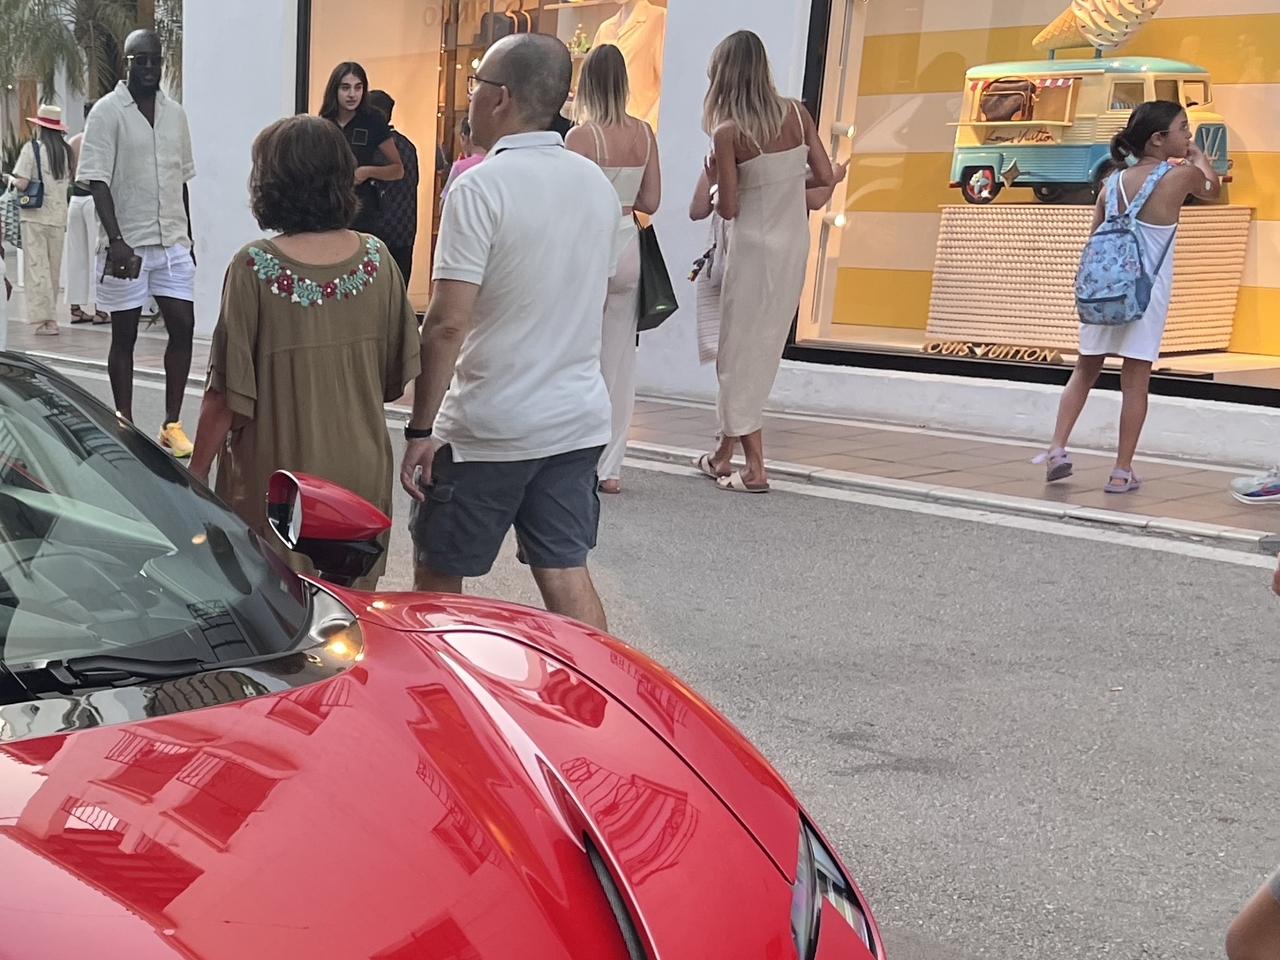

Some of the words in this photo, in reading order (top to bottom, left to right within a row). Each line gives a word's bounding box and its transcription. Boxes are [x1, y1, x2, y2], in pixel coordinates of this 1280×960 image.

[986, 130, 1014, 143] Louis
[1018, 127, 1054, 143] Vuitton
[977, 344, 1058, 363] VUITTON
